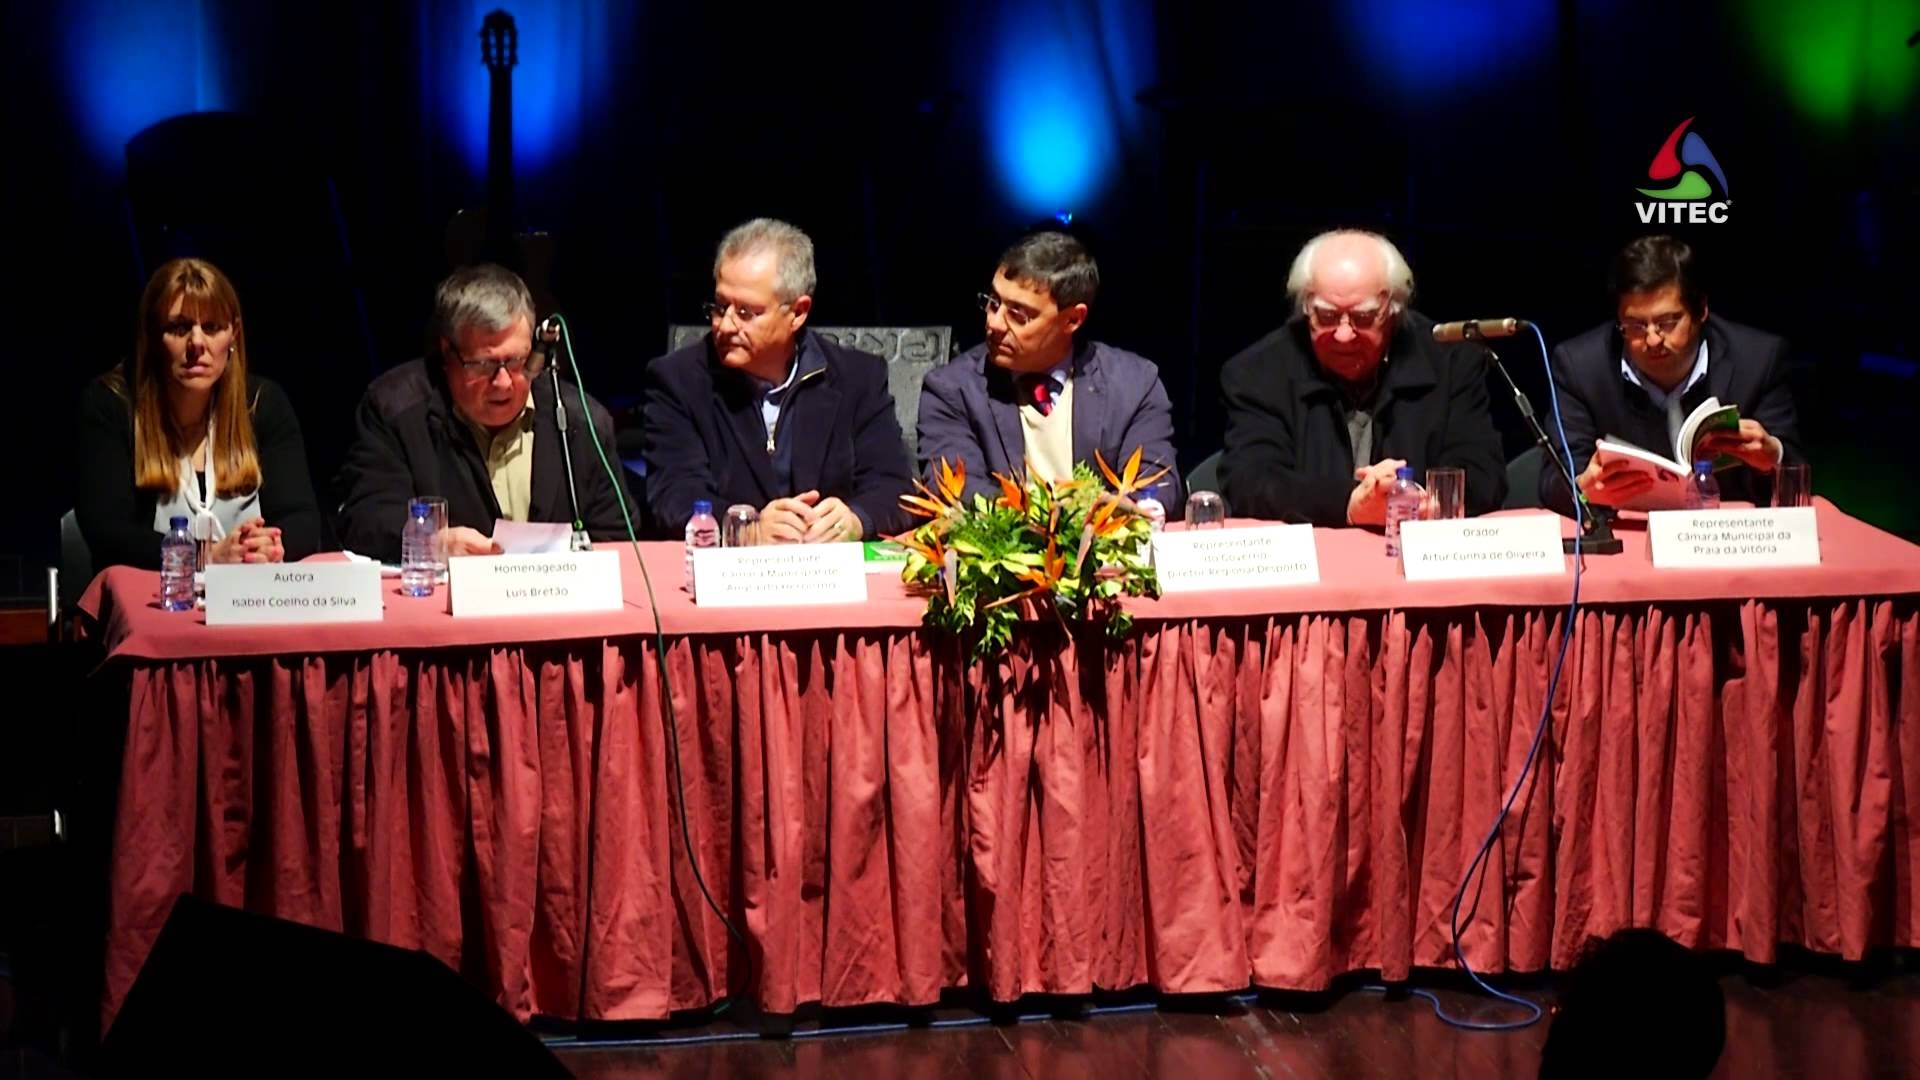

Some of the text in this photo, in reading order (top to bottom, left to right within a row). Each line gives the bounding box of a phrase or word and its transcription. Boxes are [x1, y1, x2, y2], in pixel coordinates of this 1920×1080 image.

[1692, 517, 1775, 529] Representante
[1463, 528, 1500, 538] Orador
[1677, 530, 1792, 542] Câmara Municipal da
[1422, 549, 1546, 562] Artur Cunha de Oliveira
[1693, 544, 1777, 555] Praia da Vitória
[494, 562, 577, 575] Homenageado
[273, 572, 315, 583] Autora
[231, 595, 357, 608] Isabel Coelho da Silva
